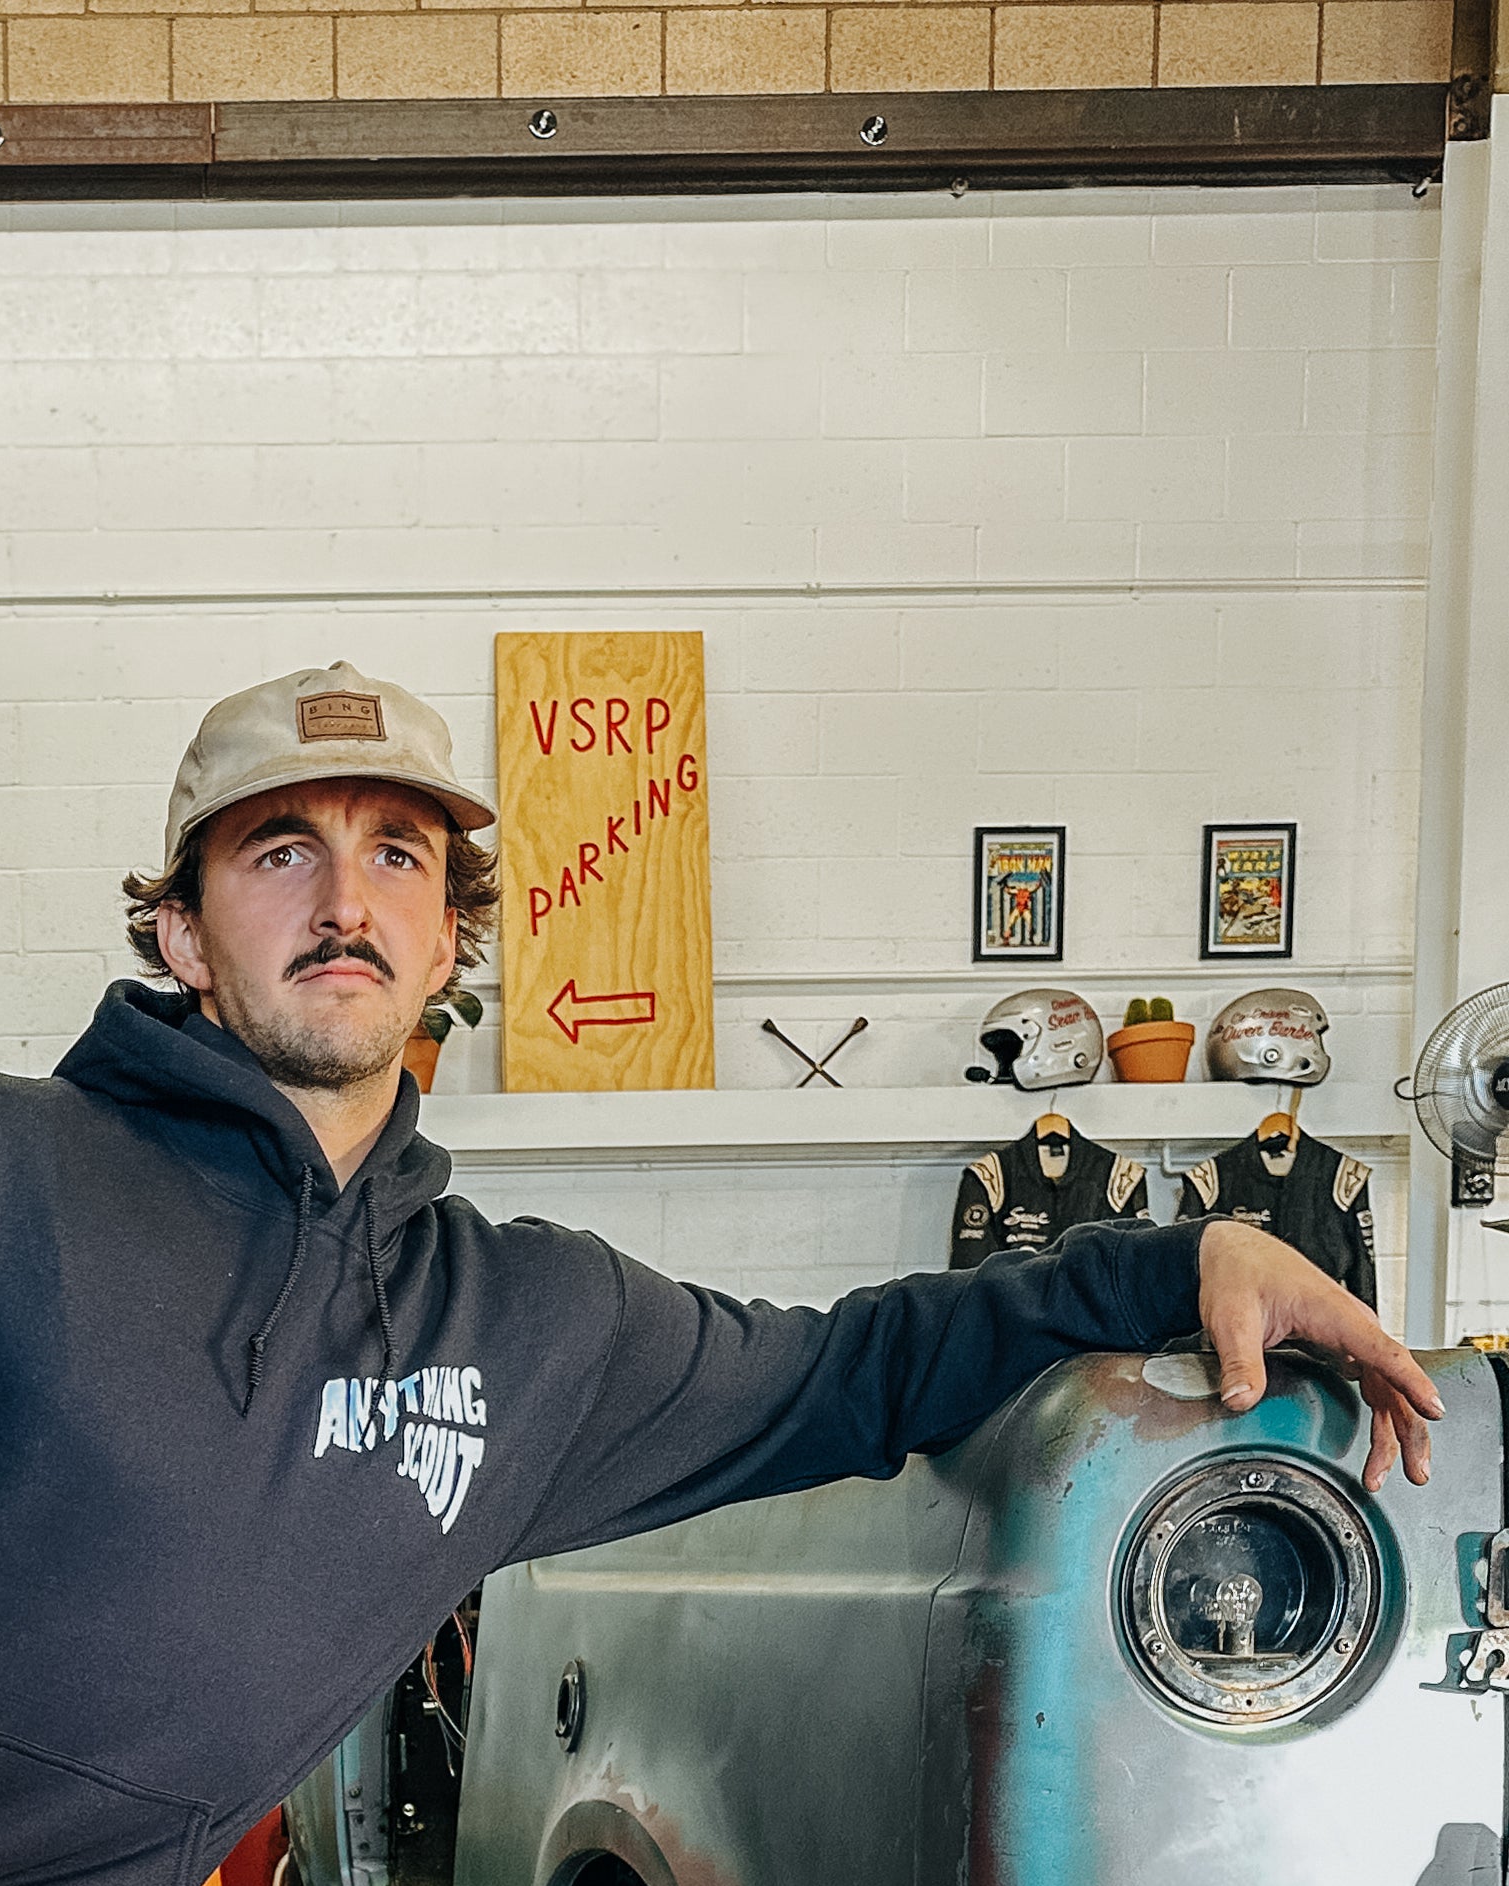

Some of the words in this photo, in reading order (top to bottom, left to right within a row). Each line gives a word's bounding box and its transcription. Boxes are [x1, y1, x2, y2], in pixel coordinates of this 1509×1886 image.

[309, 703, 371, 715] BING
[530, 698, 670, 755] VSRP
[529, 753, 699, 937] PARKING
[999, 855, 1025, 873] IRON
[1027, 855, 1053, 873] MAN
[1232, 861, 1281, 873] EARP
[313, 1366, 487, 1458] ANYTHING
[396, 1421, 485, 1535] SCOUT
